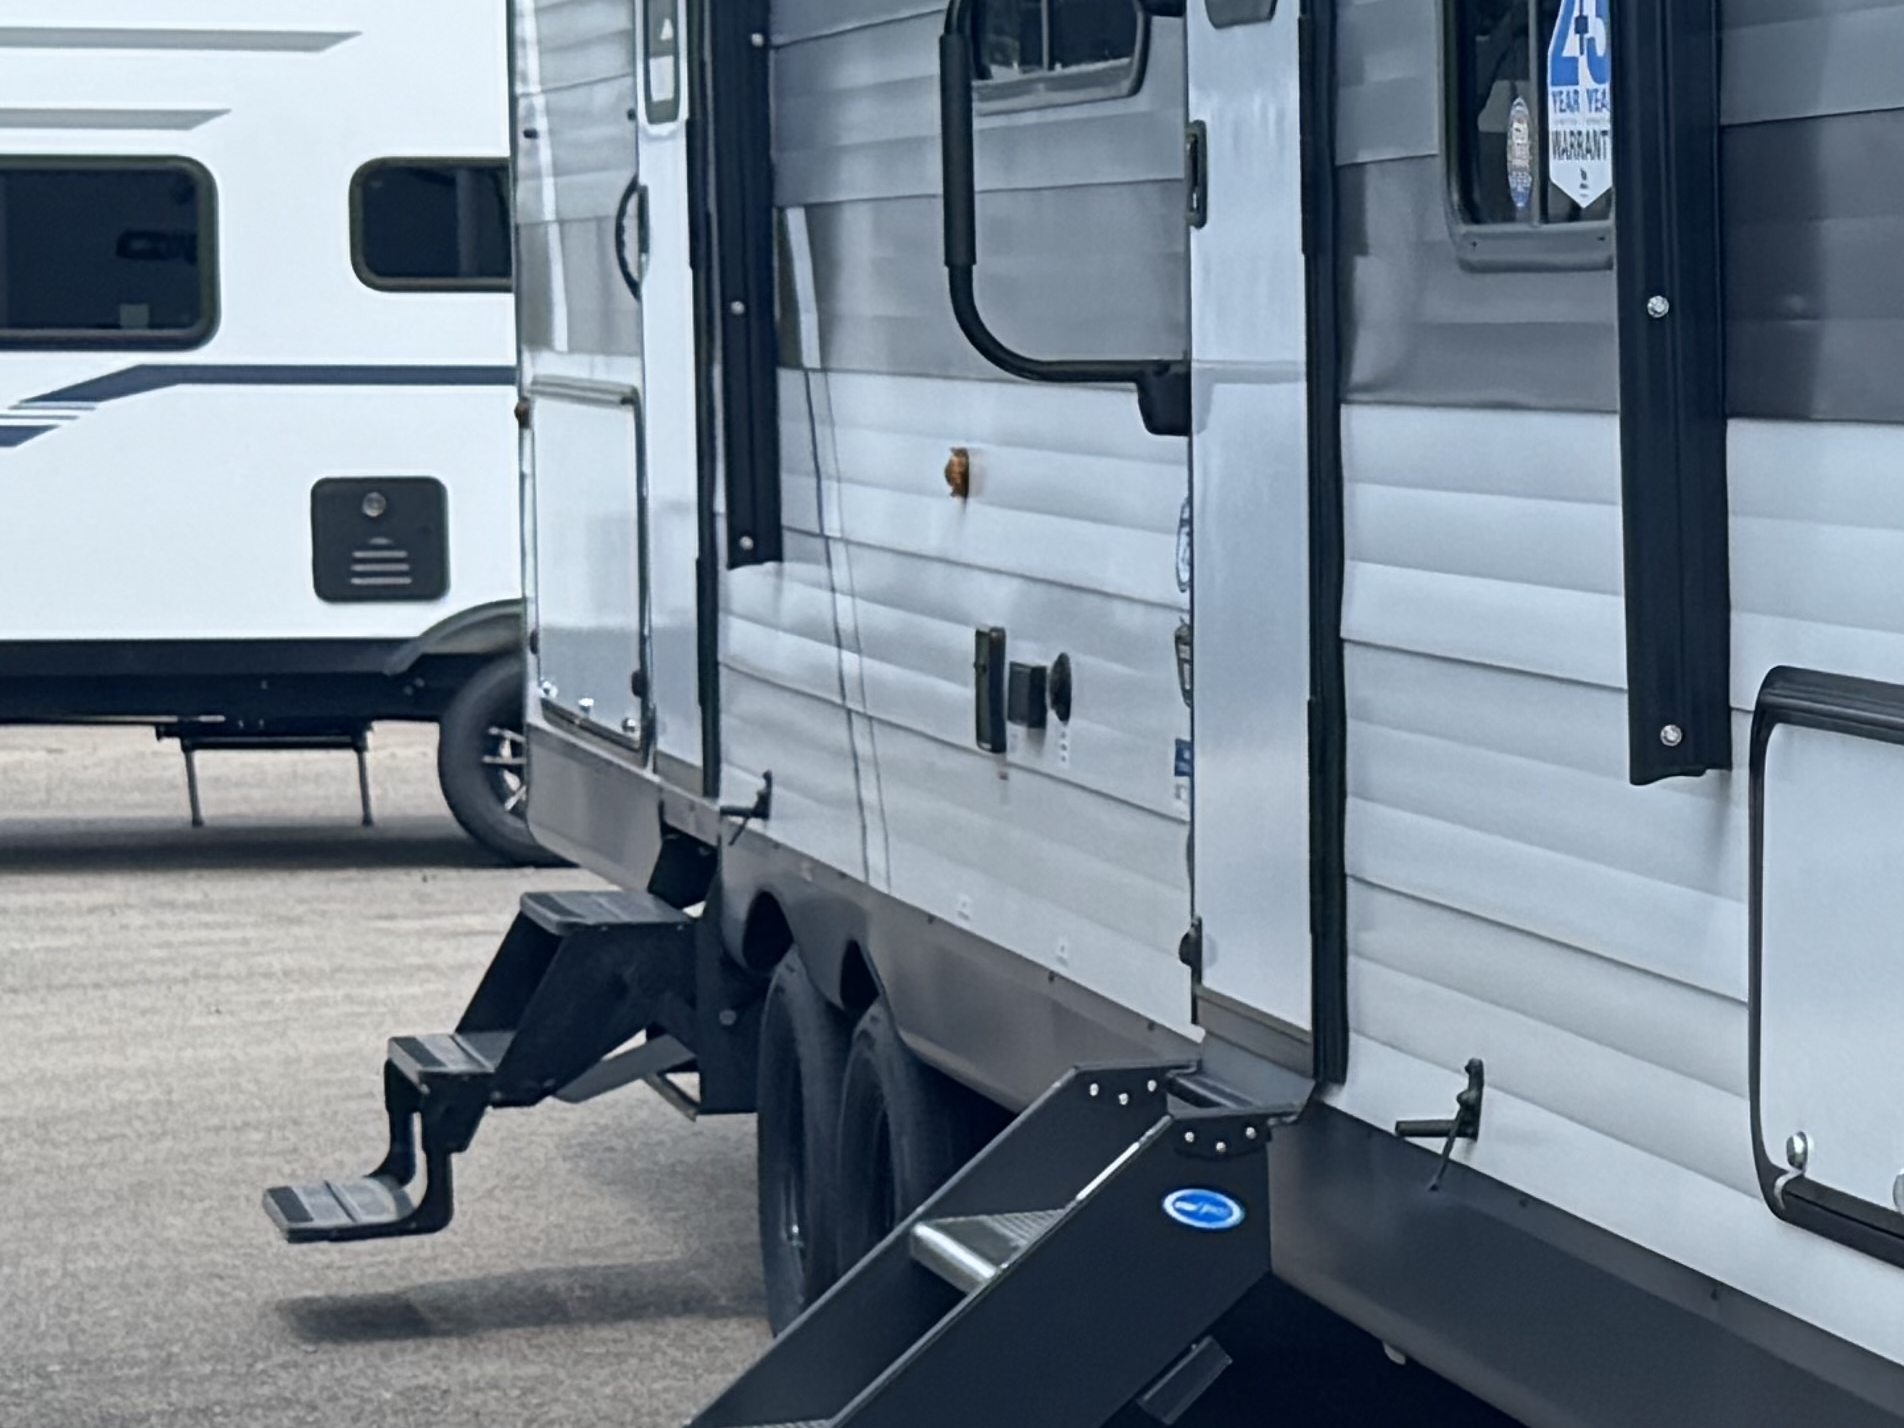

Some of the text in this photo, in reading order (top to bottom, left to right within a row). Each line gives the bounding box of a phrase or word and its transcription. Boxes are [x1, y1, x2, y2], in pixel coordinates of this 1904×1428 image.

[1551, 88, 1610, 113] YEAR YEA
[1552, 129, 1609, 161] WARRANT
